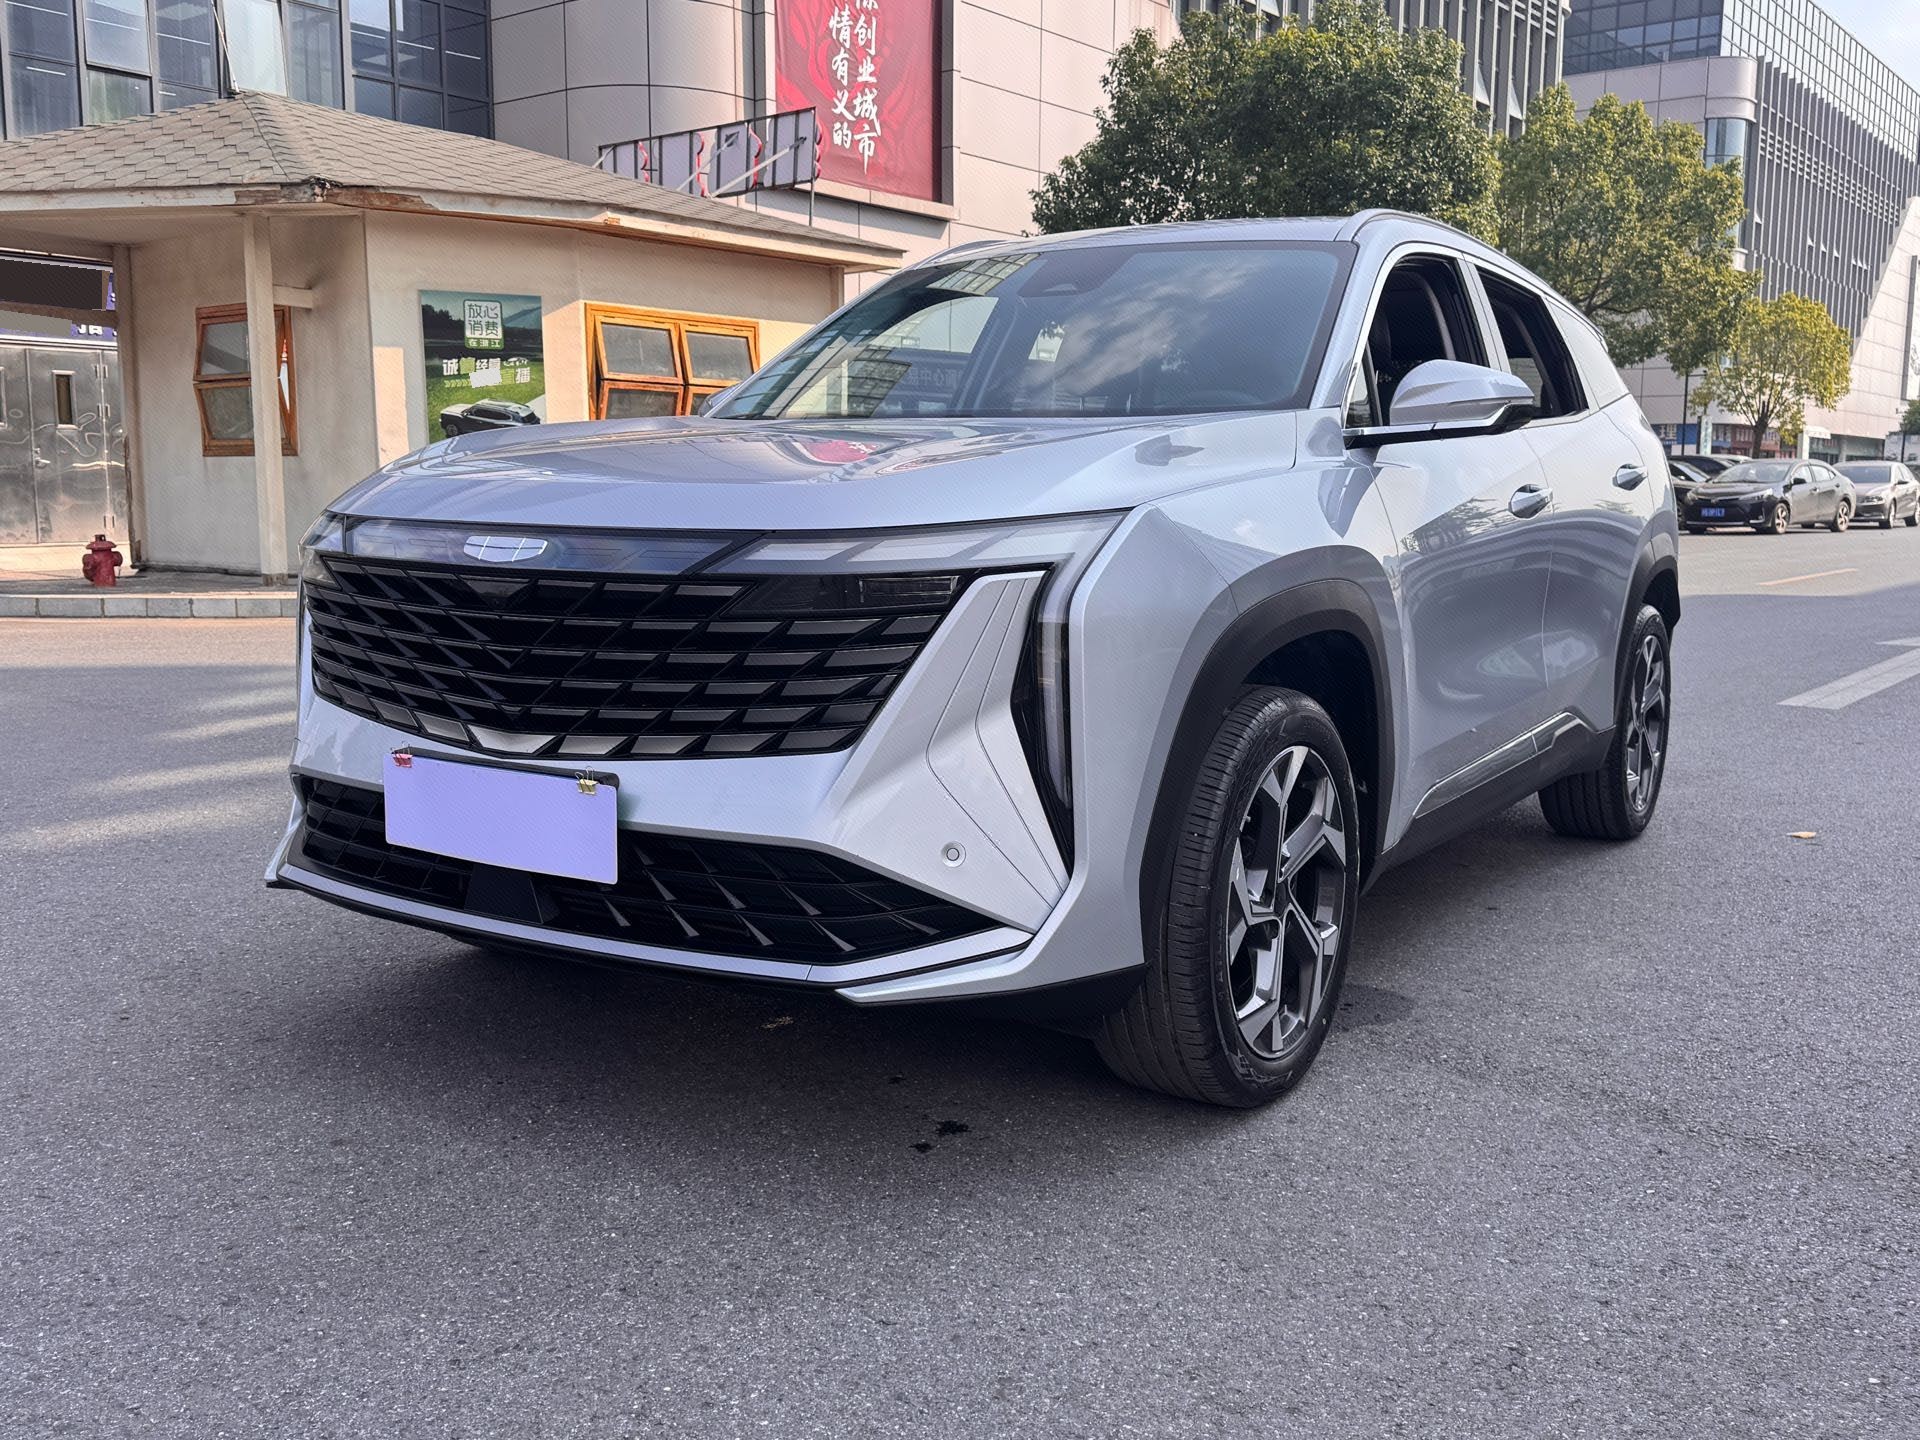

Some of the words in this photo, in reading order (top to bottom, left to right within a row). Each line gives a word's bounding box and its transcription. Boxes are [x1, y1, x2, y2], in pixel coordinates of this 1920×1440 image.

[828, 3, 854, 148] 情有义的
[467, 303, 499, 319] 放心
[468, 320, 499, 337] 消费
